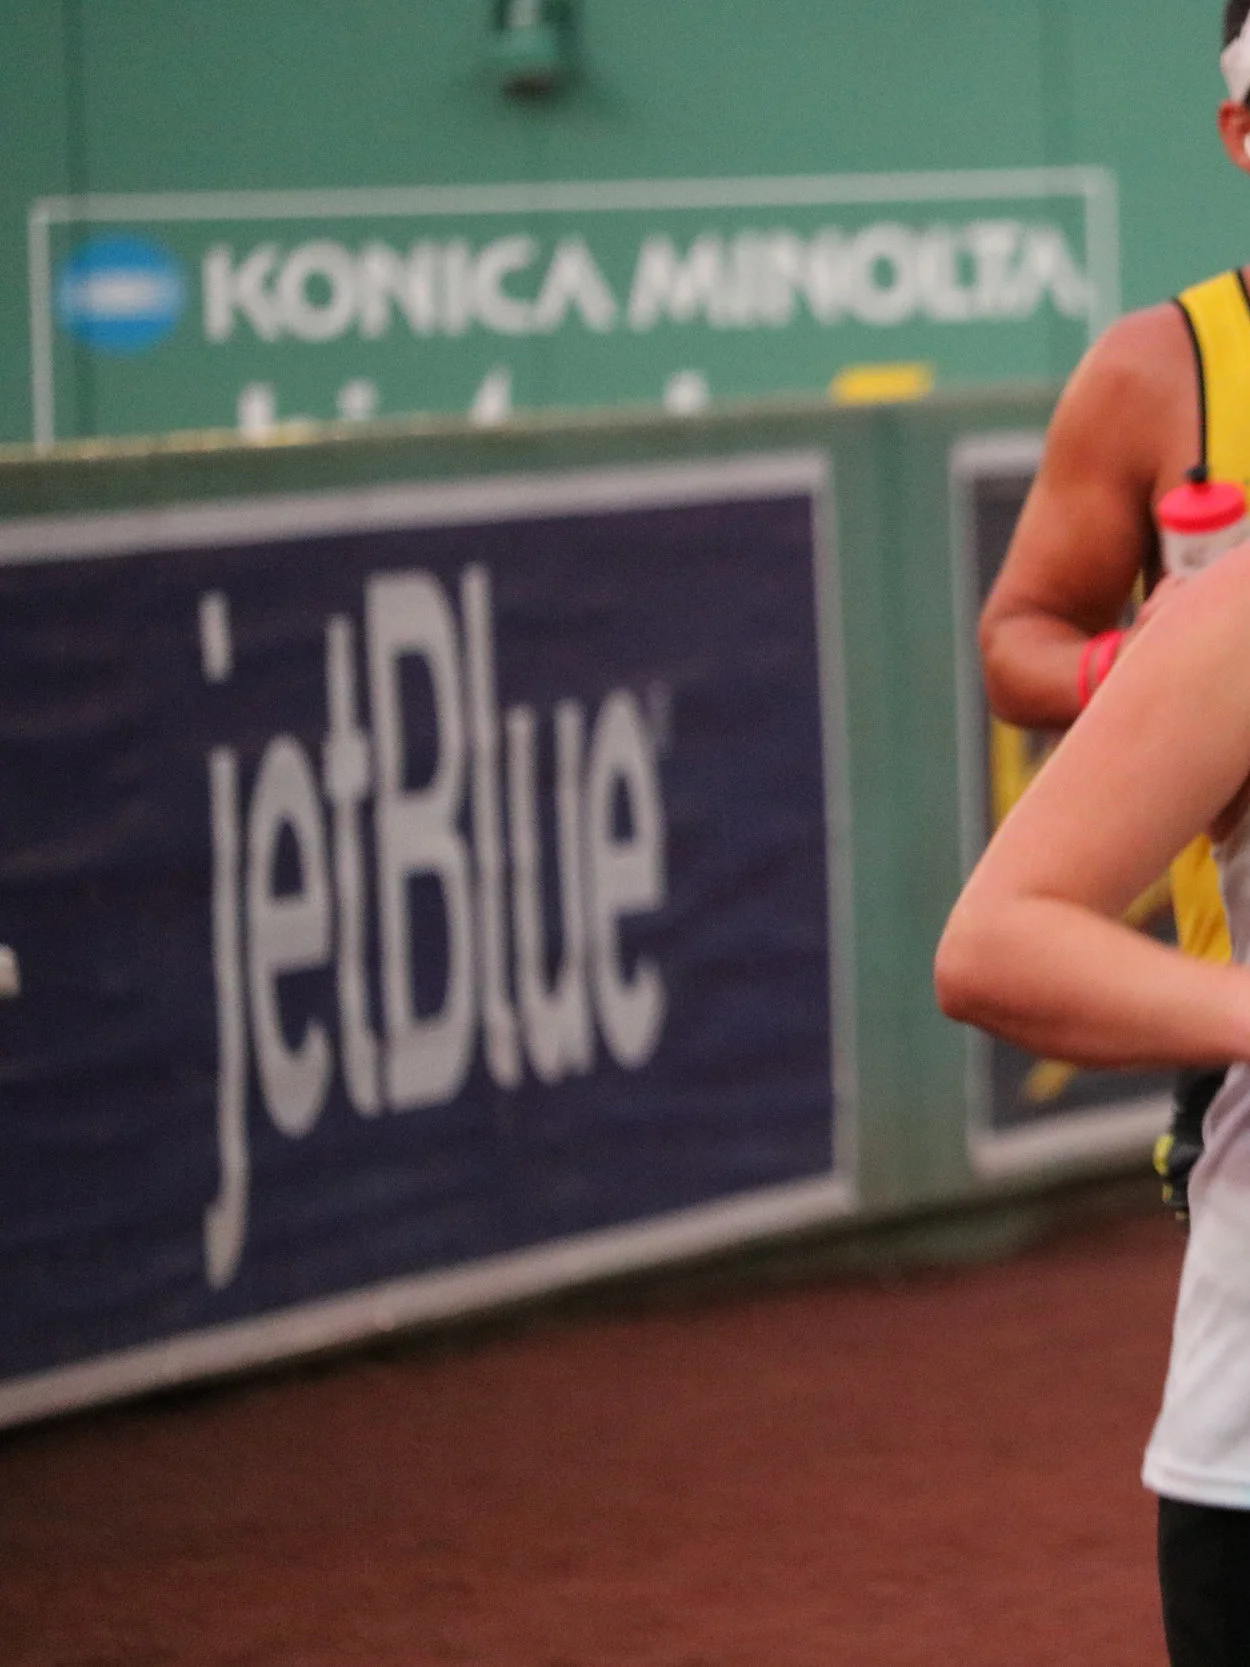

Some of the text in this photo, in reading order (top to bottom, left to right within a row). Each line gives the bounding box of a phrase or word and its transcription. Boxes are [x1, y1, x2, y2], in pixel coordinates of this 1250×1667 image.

[206, 220, 1092, 341] KONICA MINOLTA
[200, 562, 668, 1291] jetBlue
